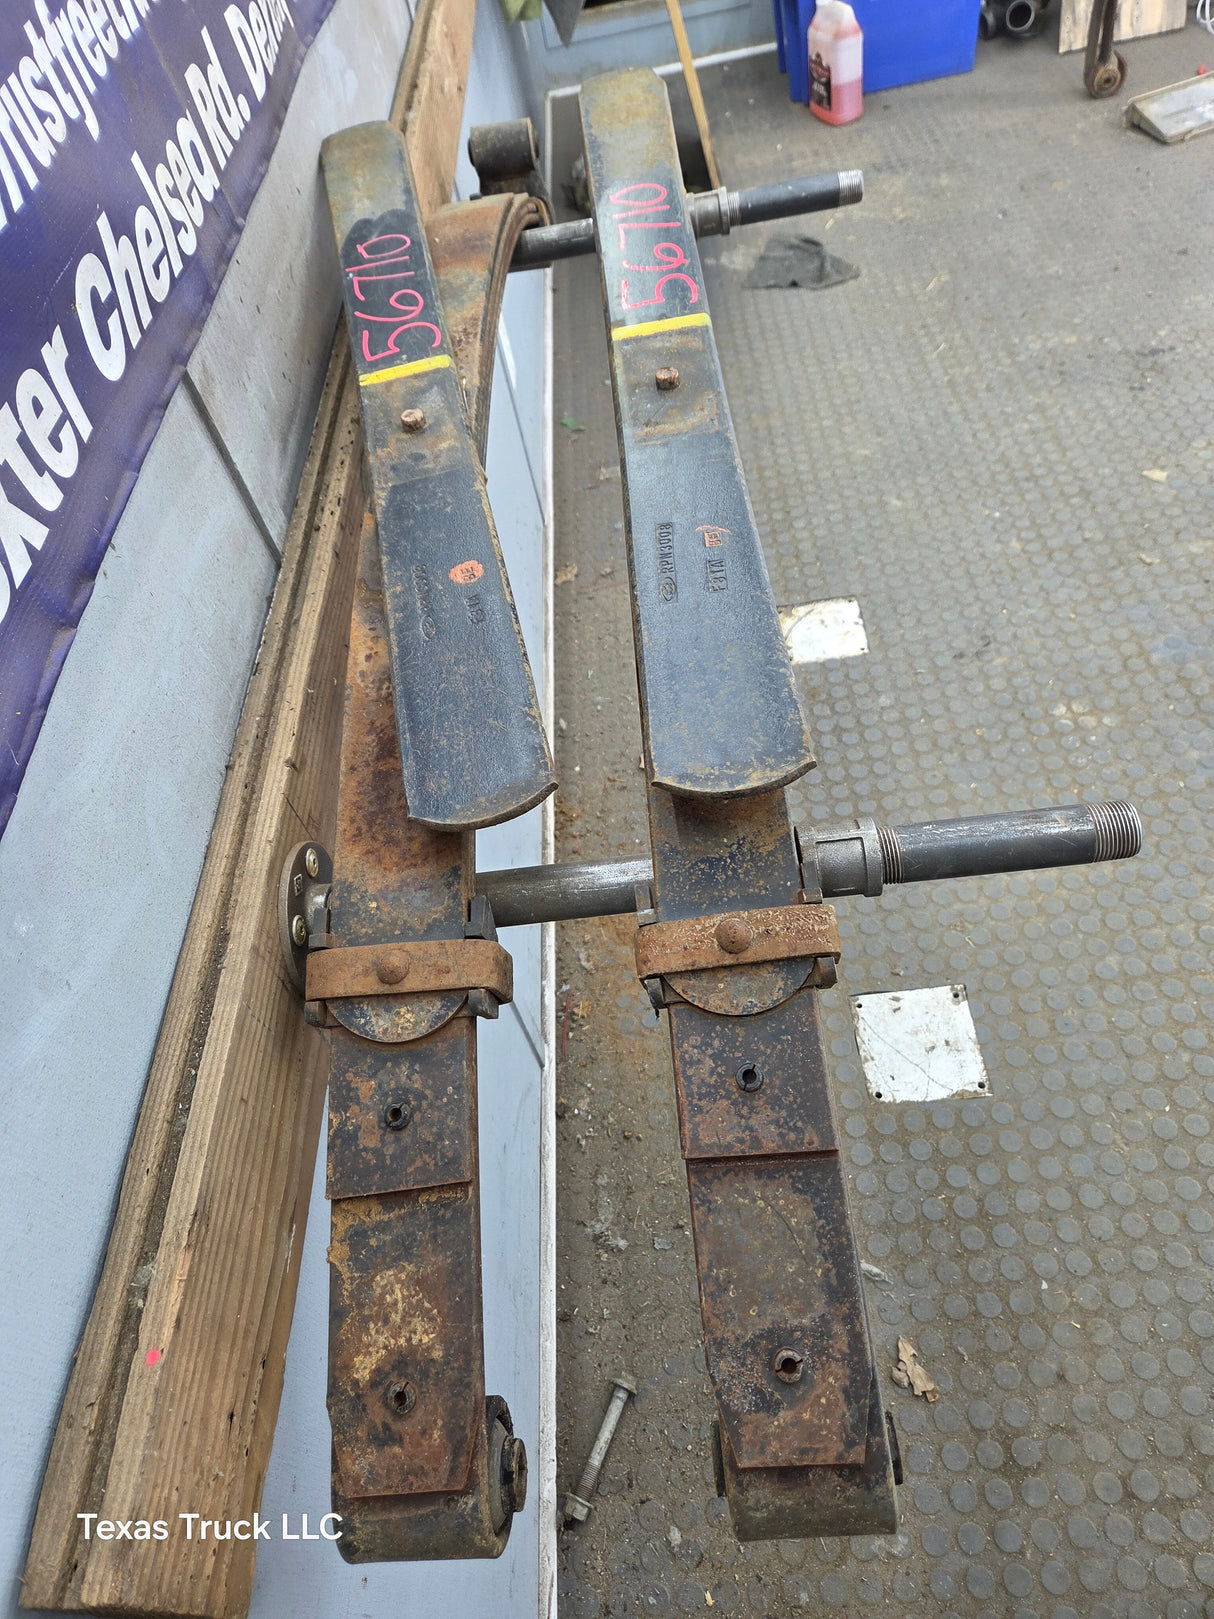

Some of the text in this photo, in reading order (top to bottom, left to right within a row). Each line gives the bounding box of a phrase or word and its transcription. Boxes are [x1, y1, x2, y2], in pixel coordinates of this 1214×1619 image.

[75, 150, 220, 381] Chelsea
[184, 25, 250, 171] Rd.
[608, 183, 698, 310] 56710
[345, 234, 442, 361] 56710
